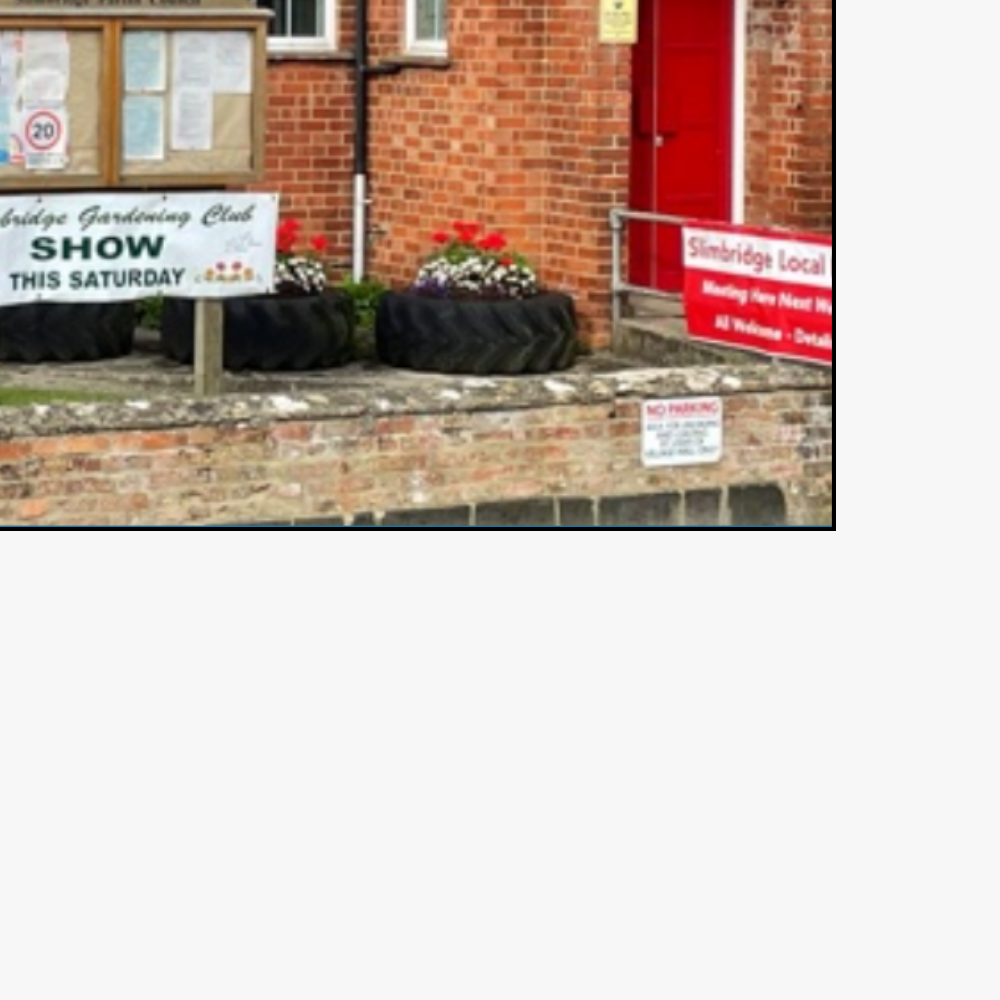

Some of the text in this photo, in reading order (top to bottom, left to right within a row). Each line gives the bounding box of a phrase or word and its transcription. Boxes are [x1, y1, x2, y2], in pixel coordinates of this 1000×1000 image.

[33, 122, 55, 140] 20
[77, 204, 192, 232] Gardening
[202, 203, 257, 228] Club
[30, 234, 165, 261] SHOW
[688, 236, 826, 275] Slimbridge Local
[9, 267, 186, 291] THIS SATURDAY
[701, 279, 748, 307] Meeting
[778, 291, 814, 312] Next
[731, 316, 783, 341] Welcome
[646, 401, 719, 417] NO PARKING
